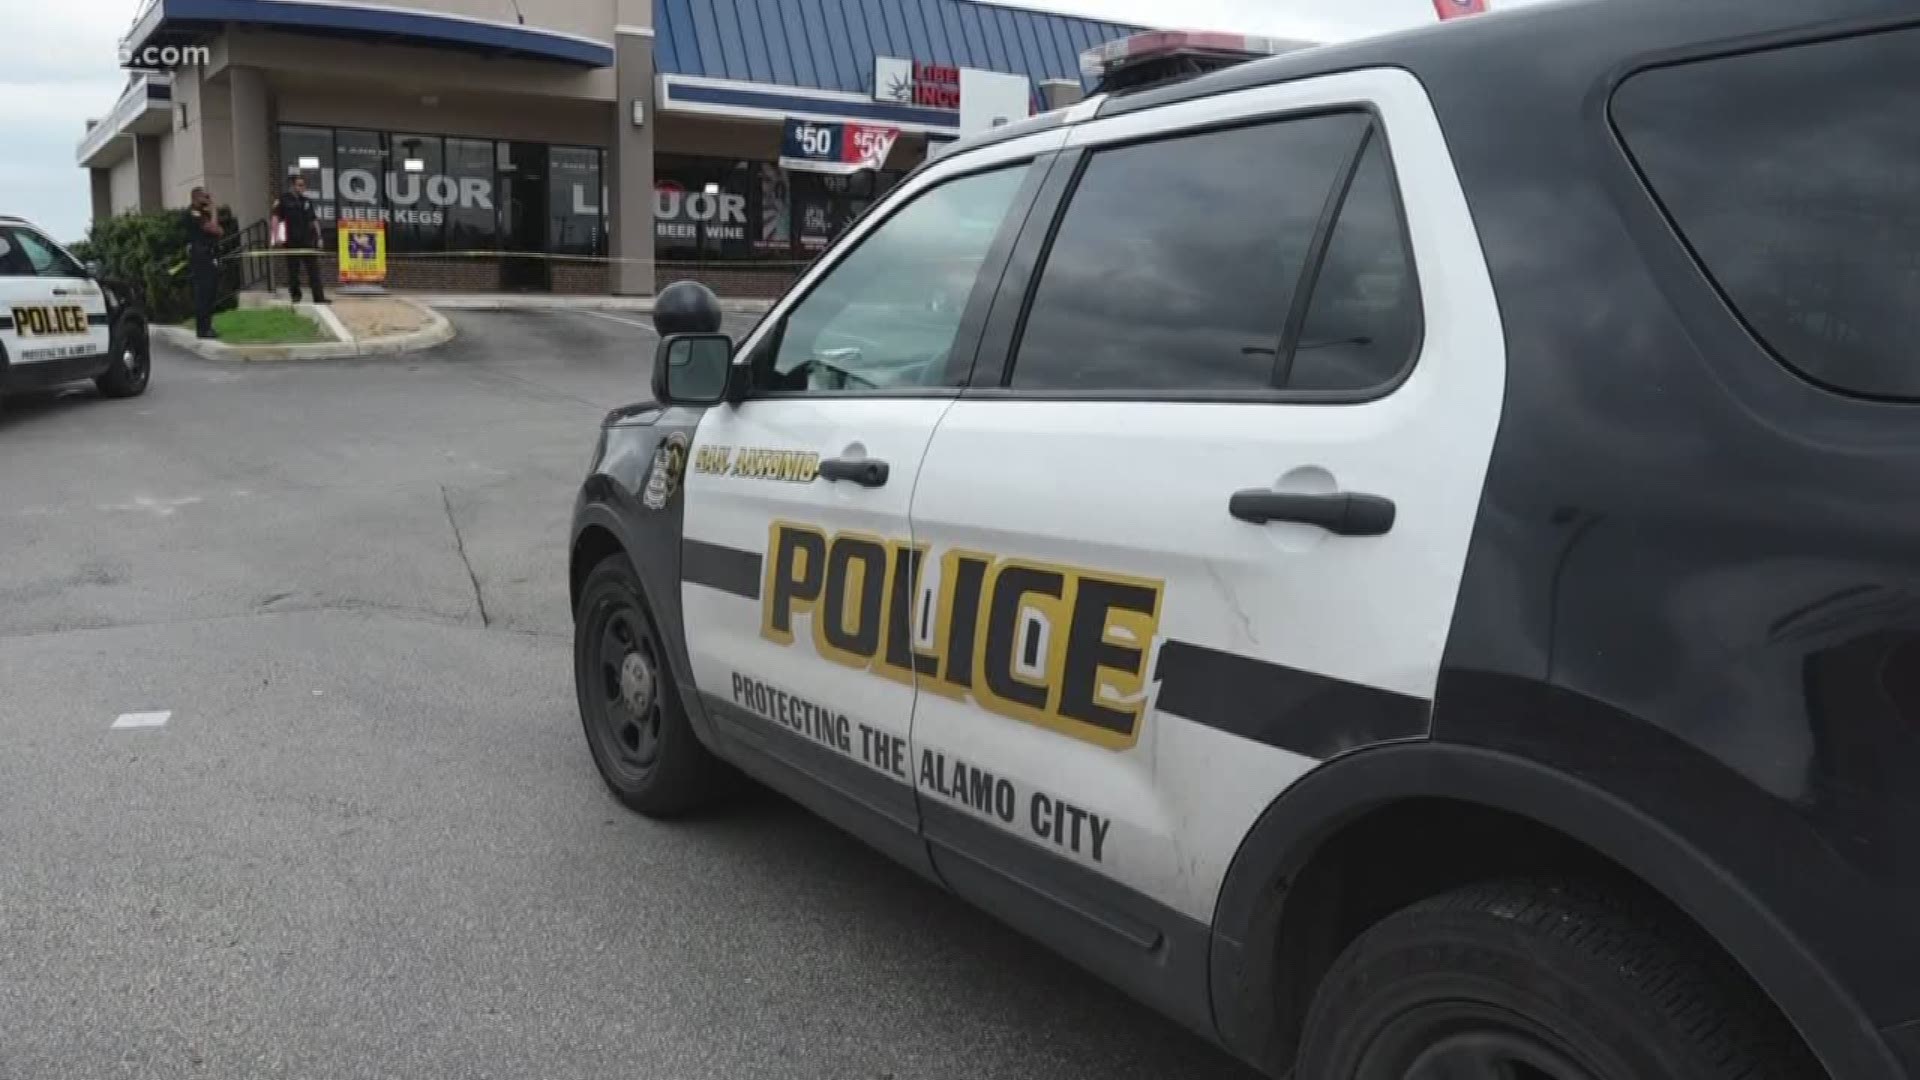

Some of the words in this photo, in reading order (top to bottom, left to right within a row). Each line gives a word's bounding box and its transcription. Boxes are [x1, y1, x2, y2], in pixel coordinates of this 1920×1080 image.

[914, 59, 960, 83] LIBE
[915, 81, 960, 107] INCO
[795, 126, 831, 155] $50
[854, 130, 888, 158] $50
[341, 206, 391, 222] BEER
[394, 208, 443, 225] KEGS
[657, 223, 696, 238] BEER
[706, 224, 745, 240] WINE
[11, 305, 88, 337] POLICE
[731, 447, 820, 484] ANTONIO
[762, 520, 1164, 750] POLICE
[731, 671, 852, 755] PROTECTING
[858, 723, 906, 779] THE
[919, 748, 1016, 824] ALAMO
[1030, 791, 1111, 863] CITY
